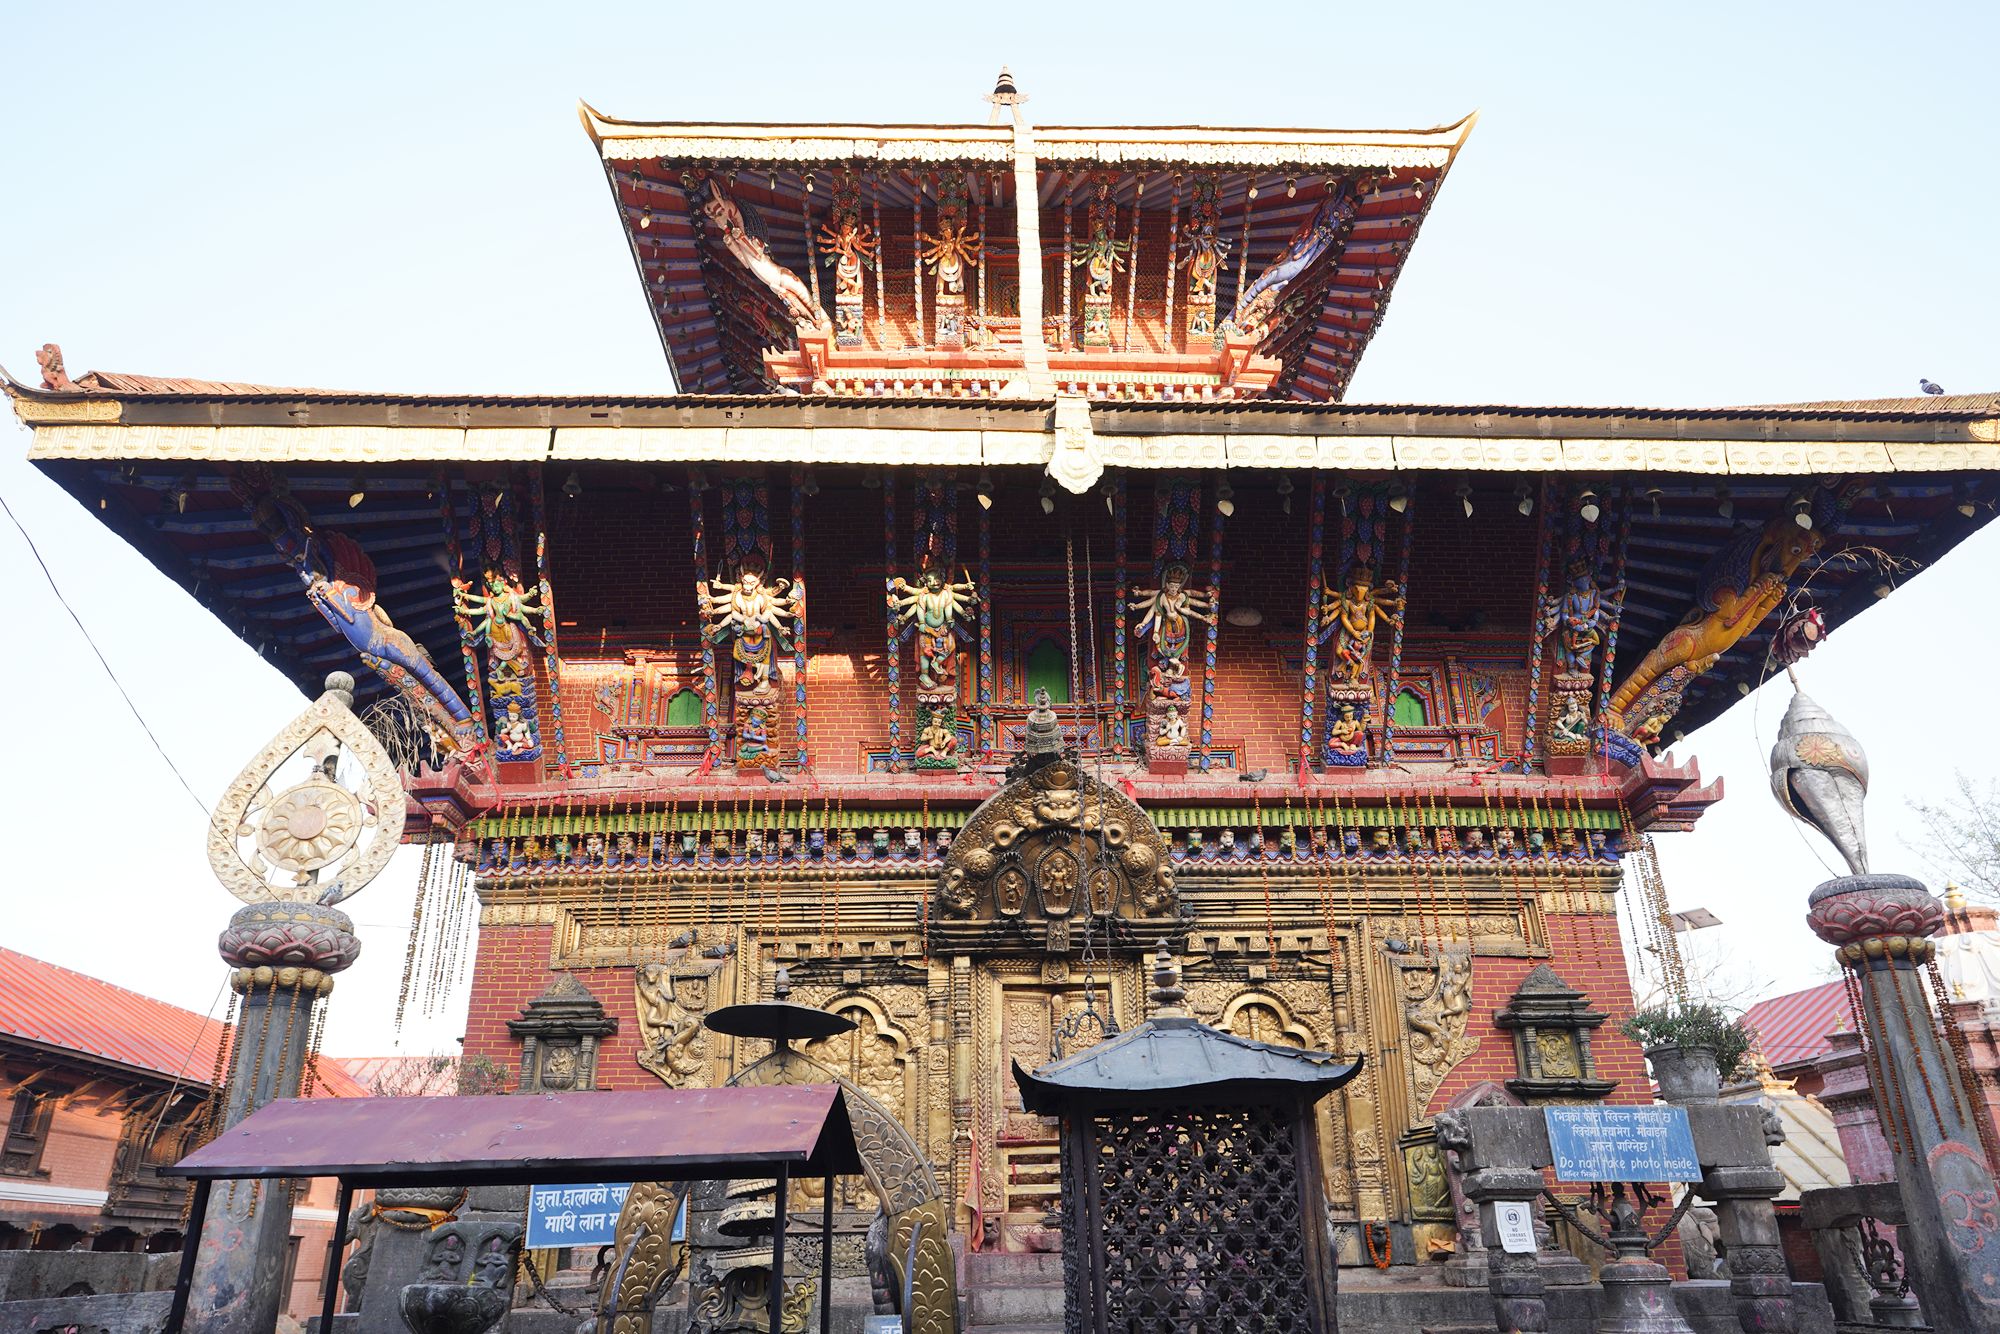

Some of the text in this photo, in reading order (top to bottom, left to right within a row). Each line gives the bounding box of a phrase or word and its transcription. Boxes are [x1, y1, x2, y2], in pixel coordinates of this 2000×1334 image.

[1560, 1156, 1574, 1168] Do
[1579, 1157, 1597, 1169] not
[1631, 1157, 1661, 1172] photo
[1664, 1157, 1697, 1170] inside.
